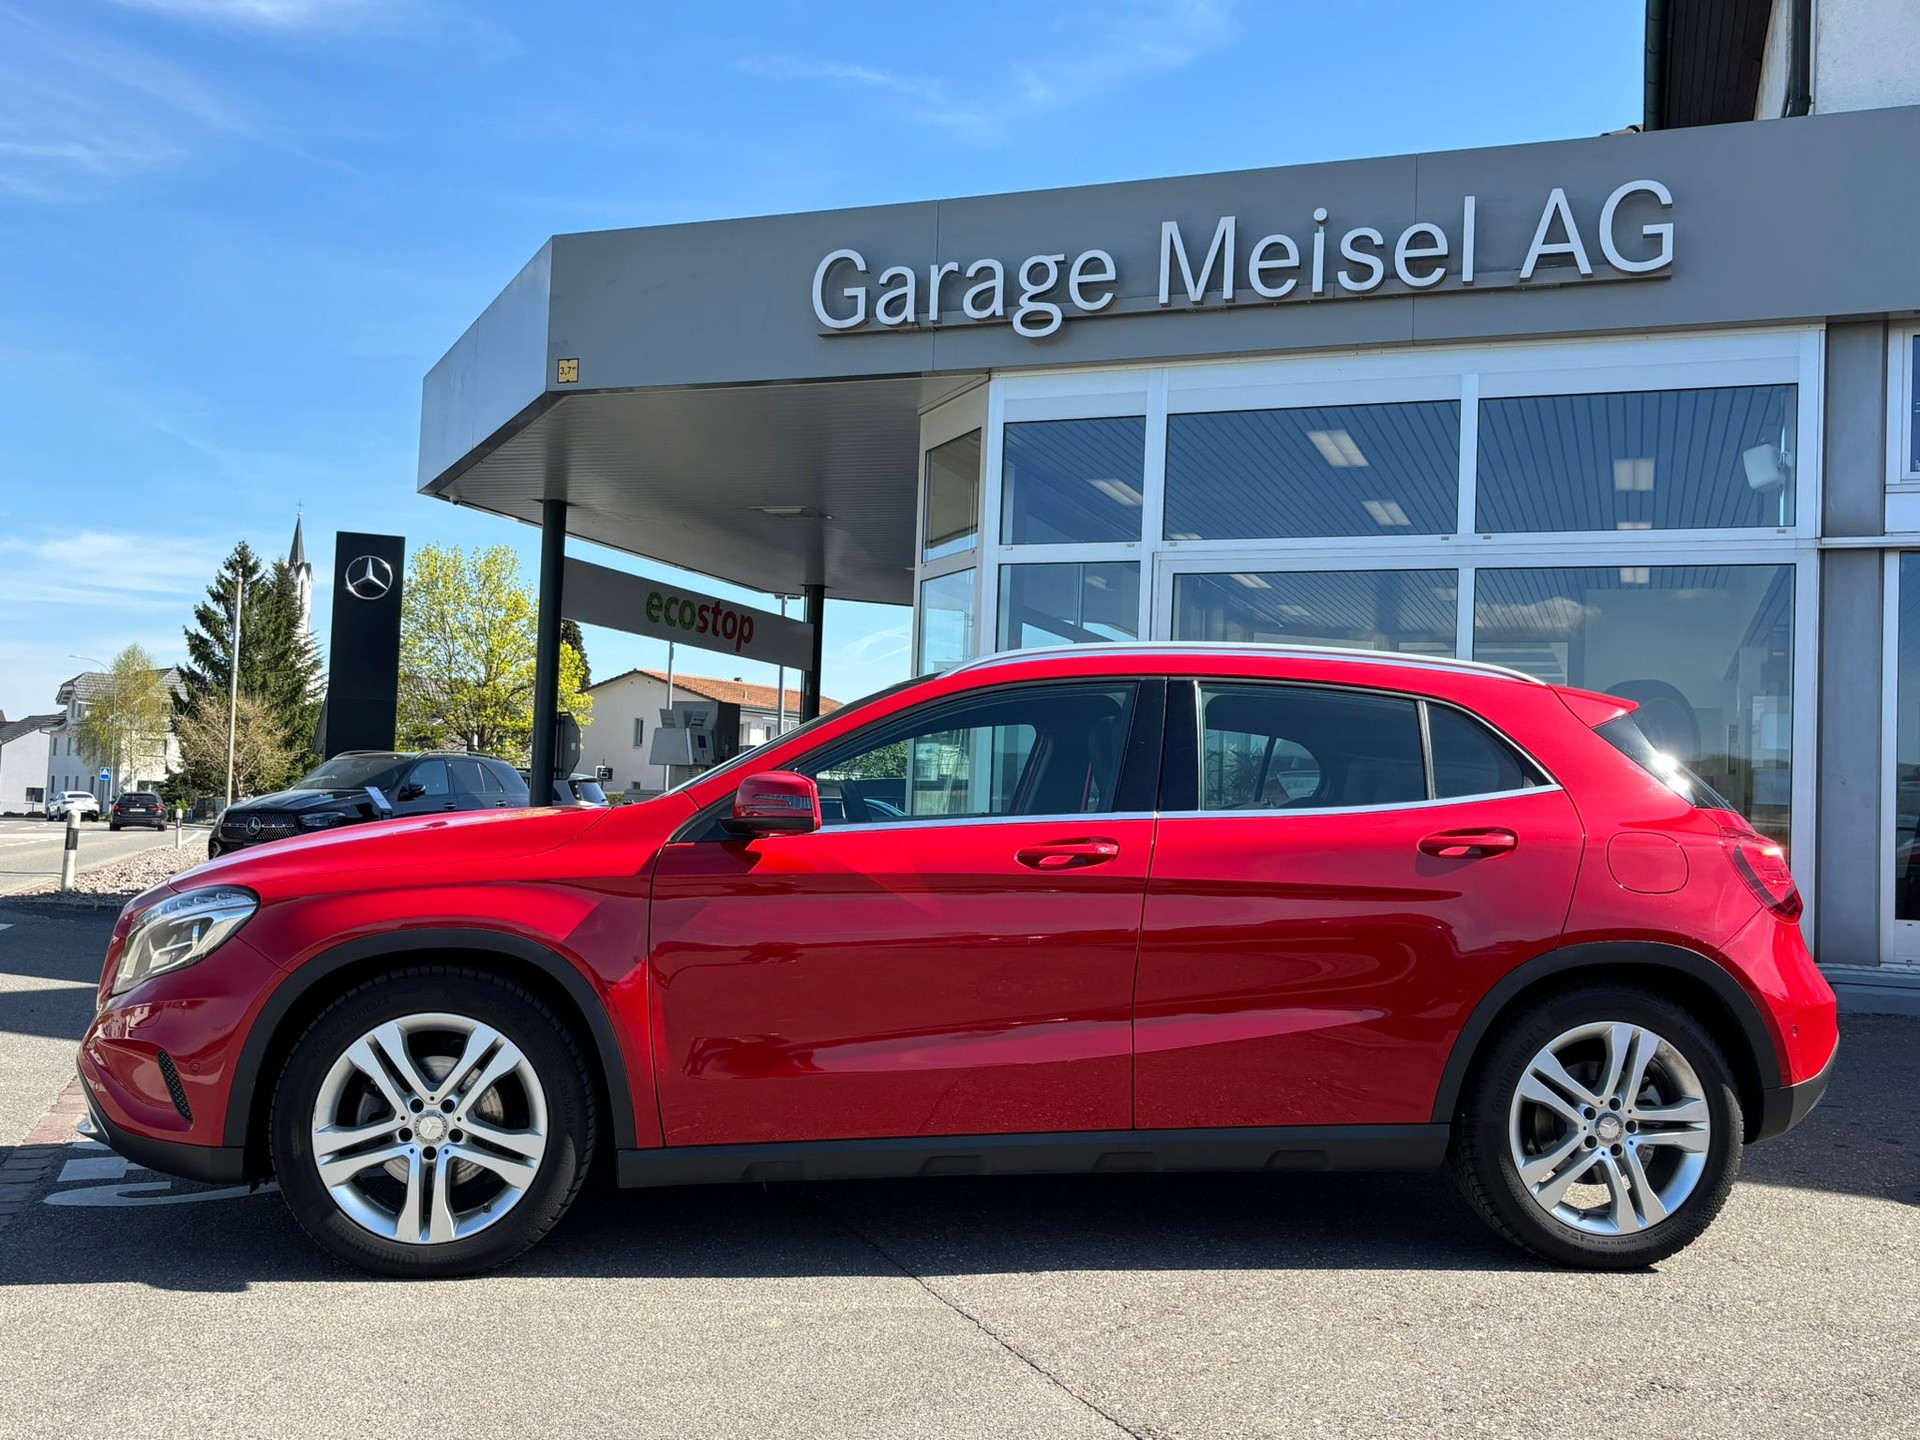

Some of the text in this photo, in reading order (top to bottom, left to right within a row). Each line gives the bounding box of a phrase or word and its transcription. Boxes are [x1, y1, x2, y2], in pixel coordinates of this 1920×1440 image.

[812, 179, 1674, 338] Garage Meisel AG
[645, 591, 754, 652] ecostop
